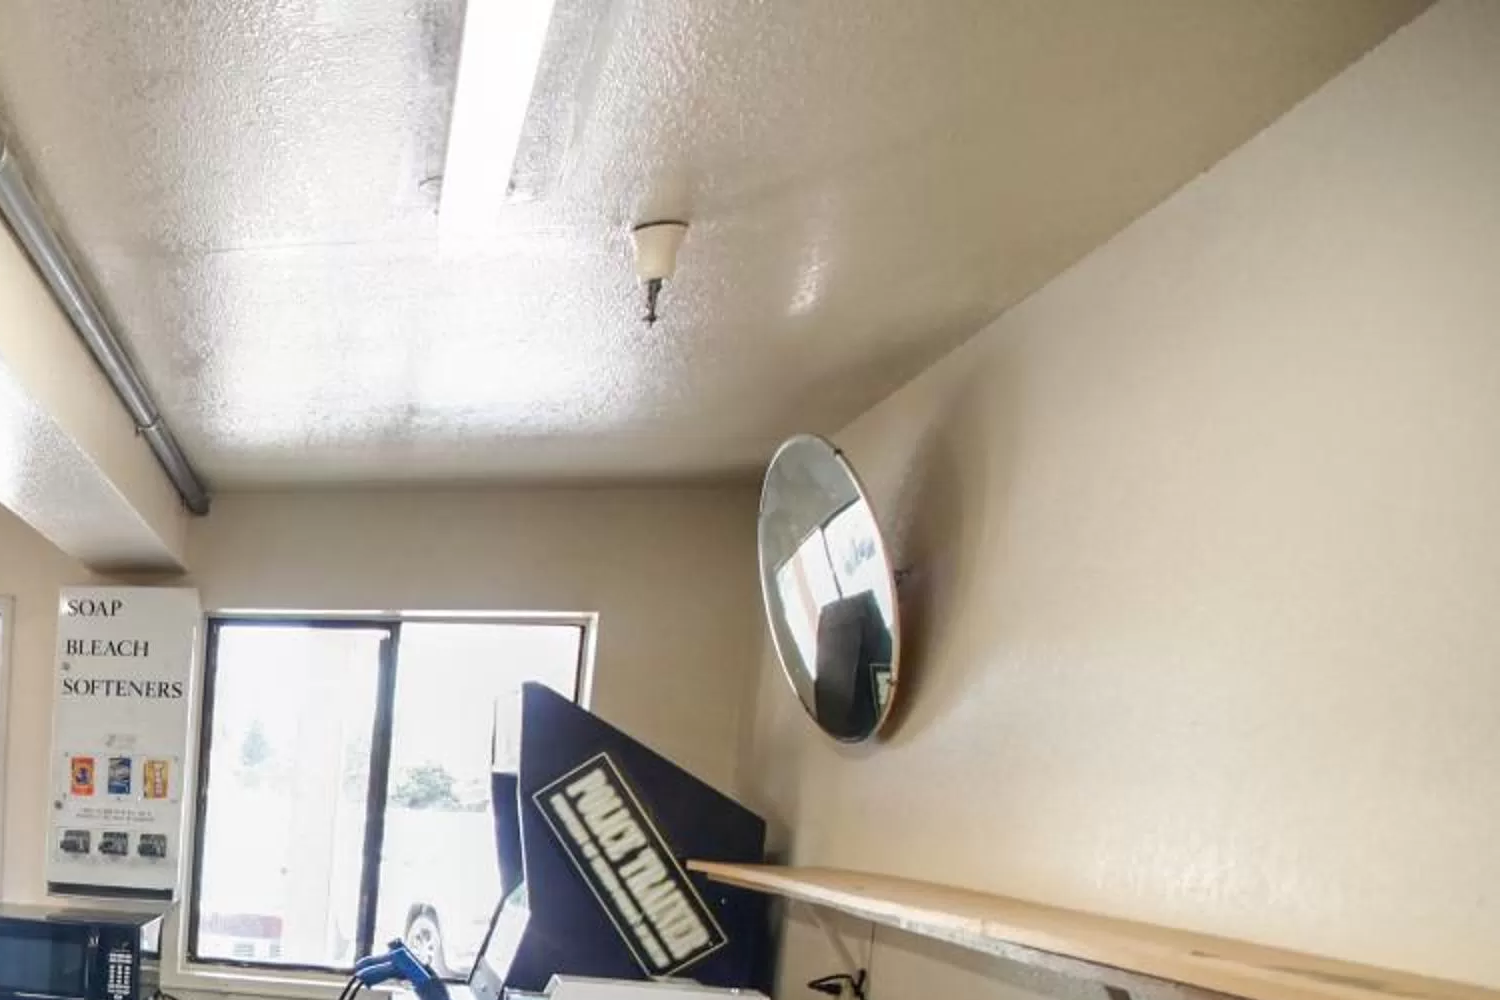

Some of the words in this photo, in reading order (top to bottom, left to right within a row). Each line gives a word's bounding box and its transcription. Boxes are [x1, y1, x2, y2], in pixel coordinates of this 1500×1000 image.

[67, 599, 122, 617] SOAP
[66, 639, 149, 657] BLEACH
[62, 679, 183, 699] SOFTENERS
[565, 768, 648, 863] POLICE
[618, 847, 710, 960] TRAINER
